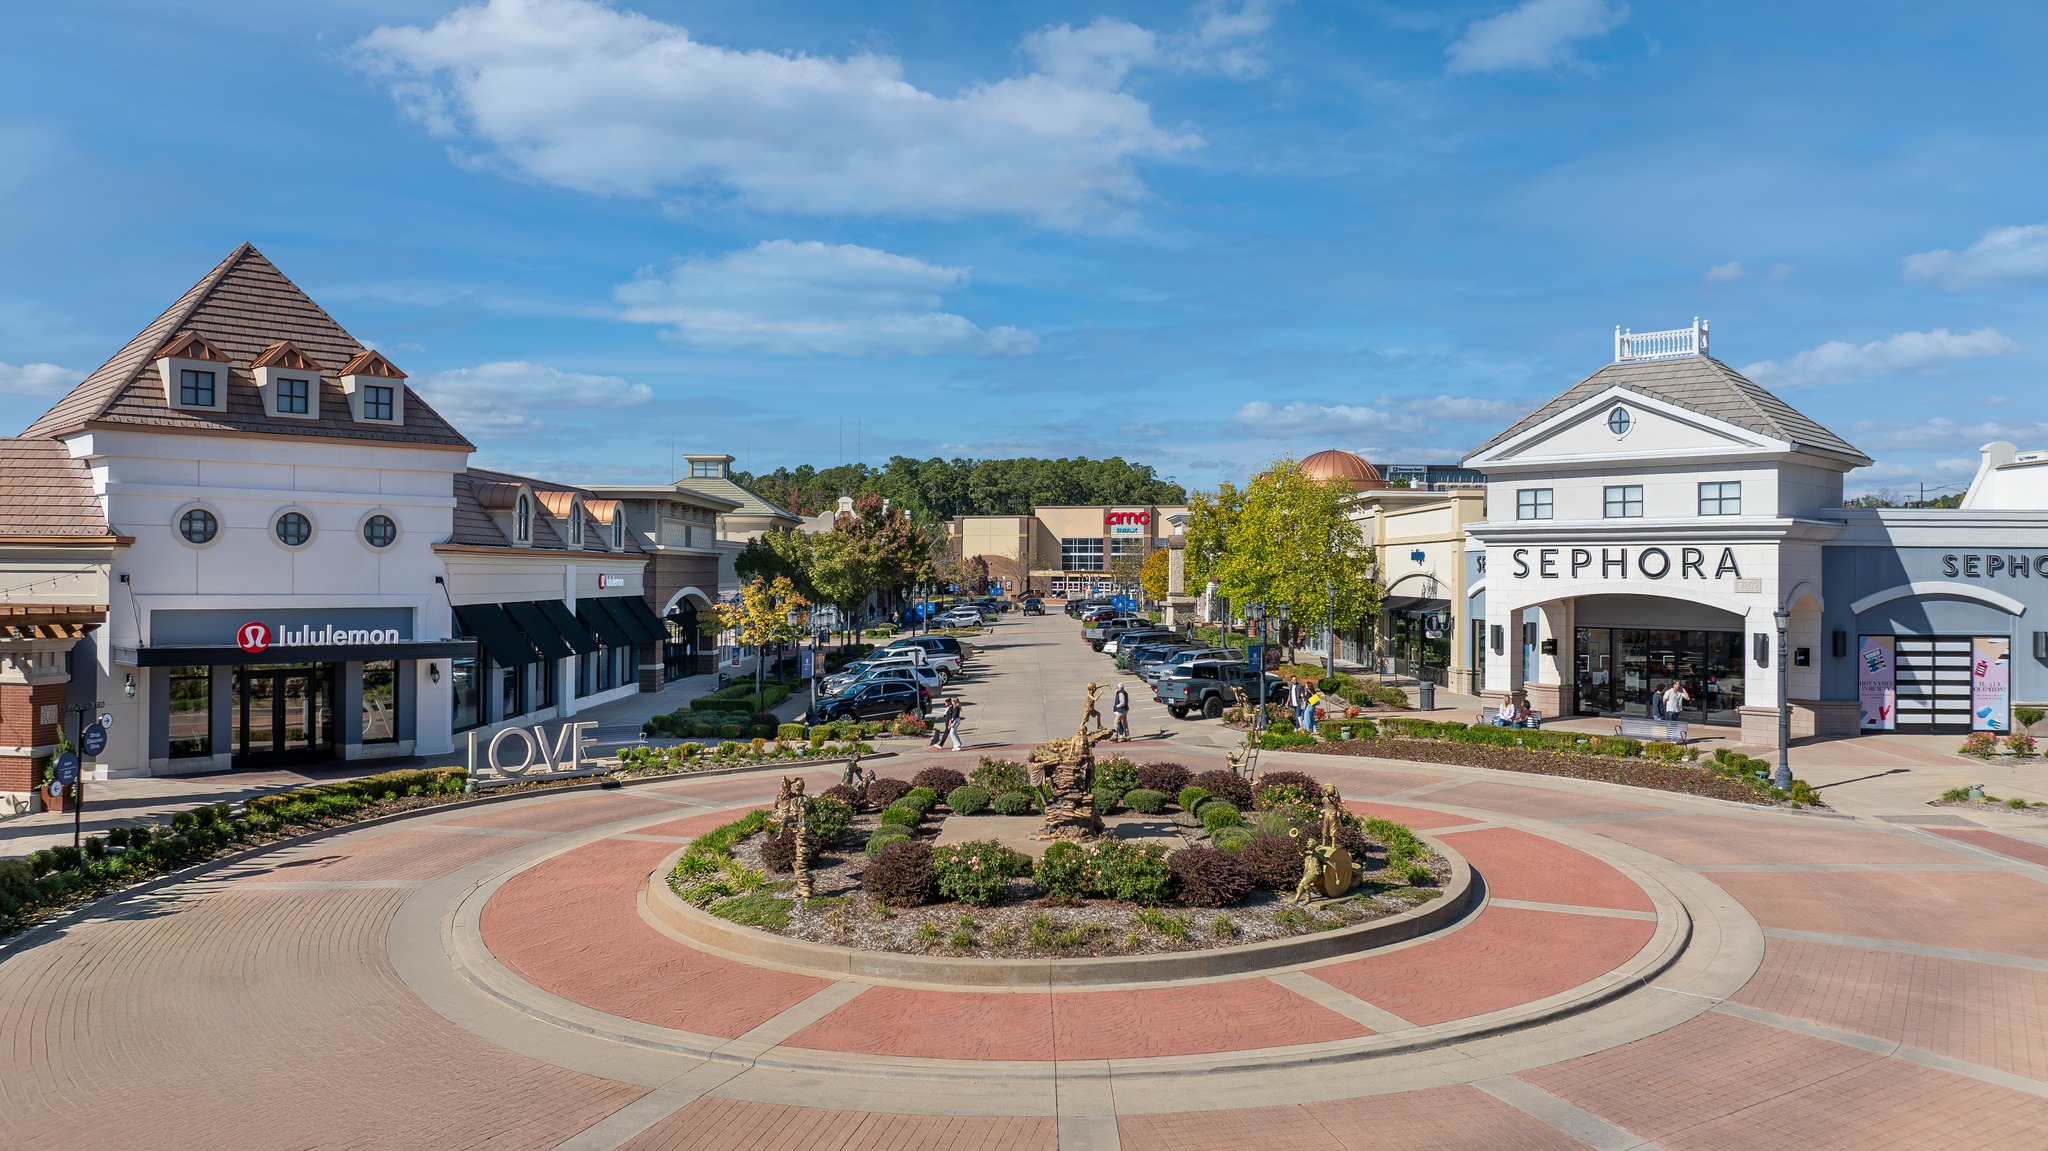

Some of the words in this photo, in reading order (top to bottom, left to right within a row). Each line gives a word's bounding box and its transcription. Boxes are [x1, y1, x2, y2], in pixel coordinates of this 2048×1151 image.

[1105, 511, 1150, 525] amc
[1513, 547, 1742, 580] SEPHORA
[280, 624, 399, 647] lululemon
[468, 721, 599, 779] LOVE
